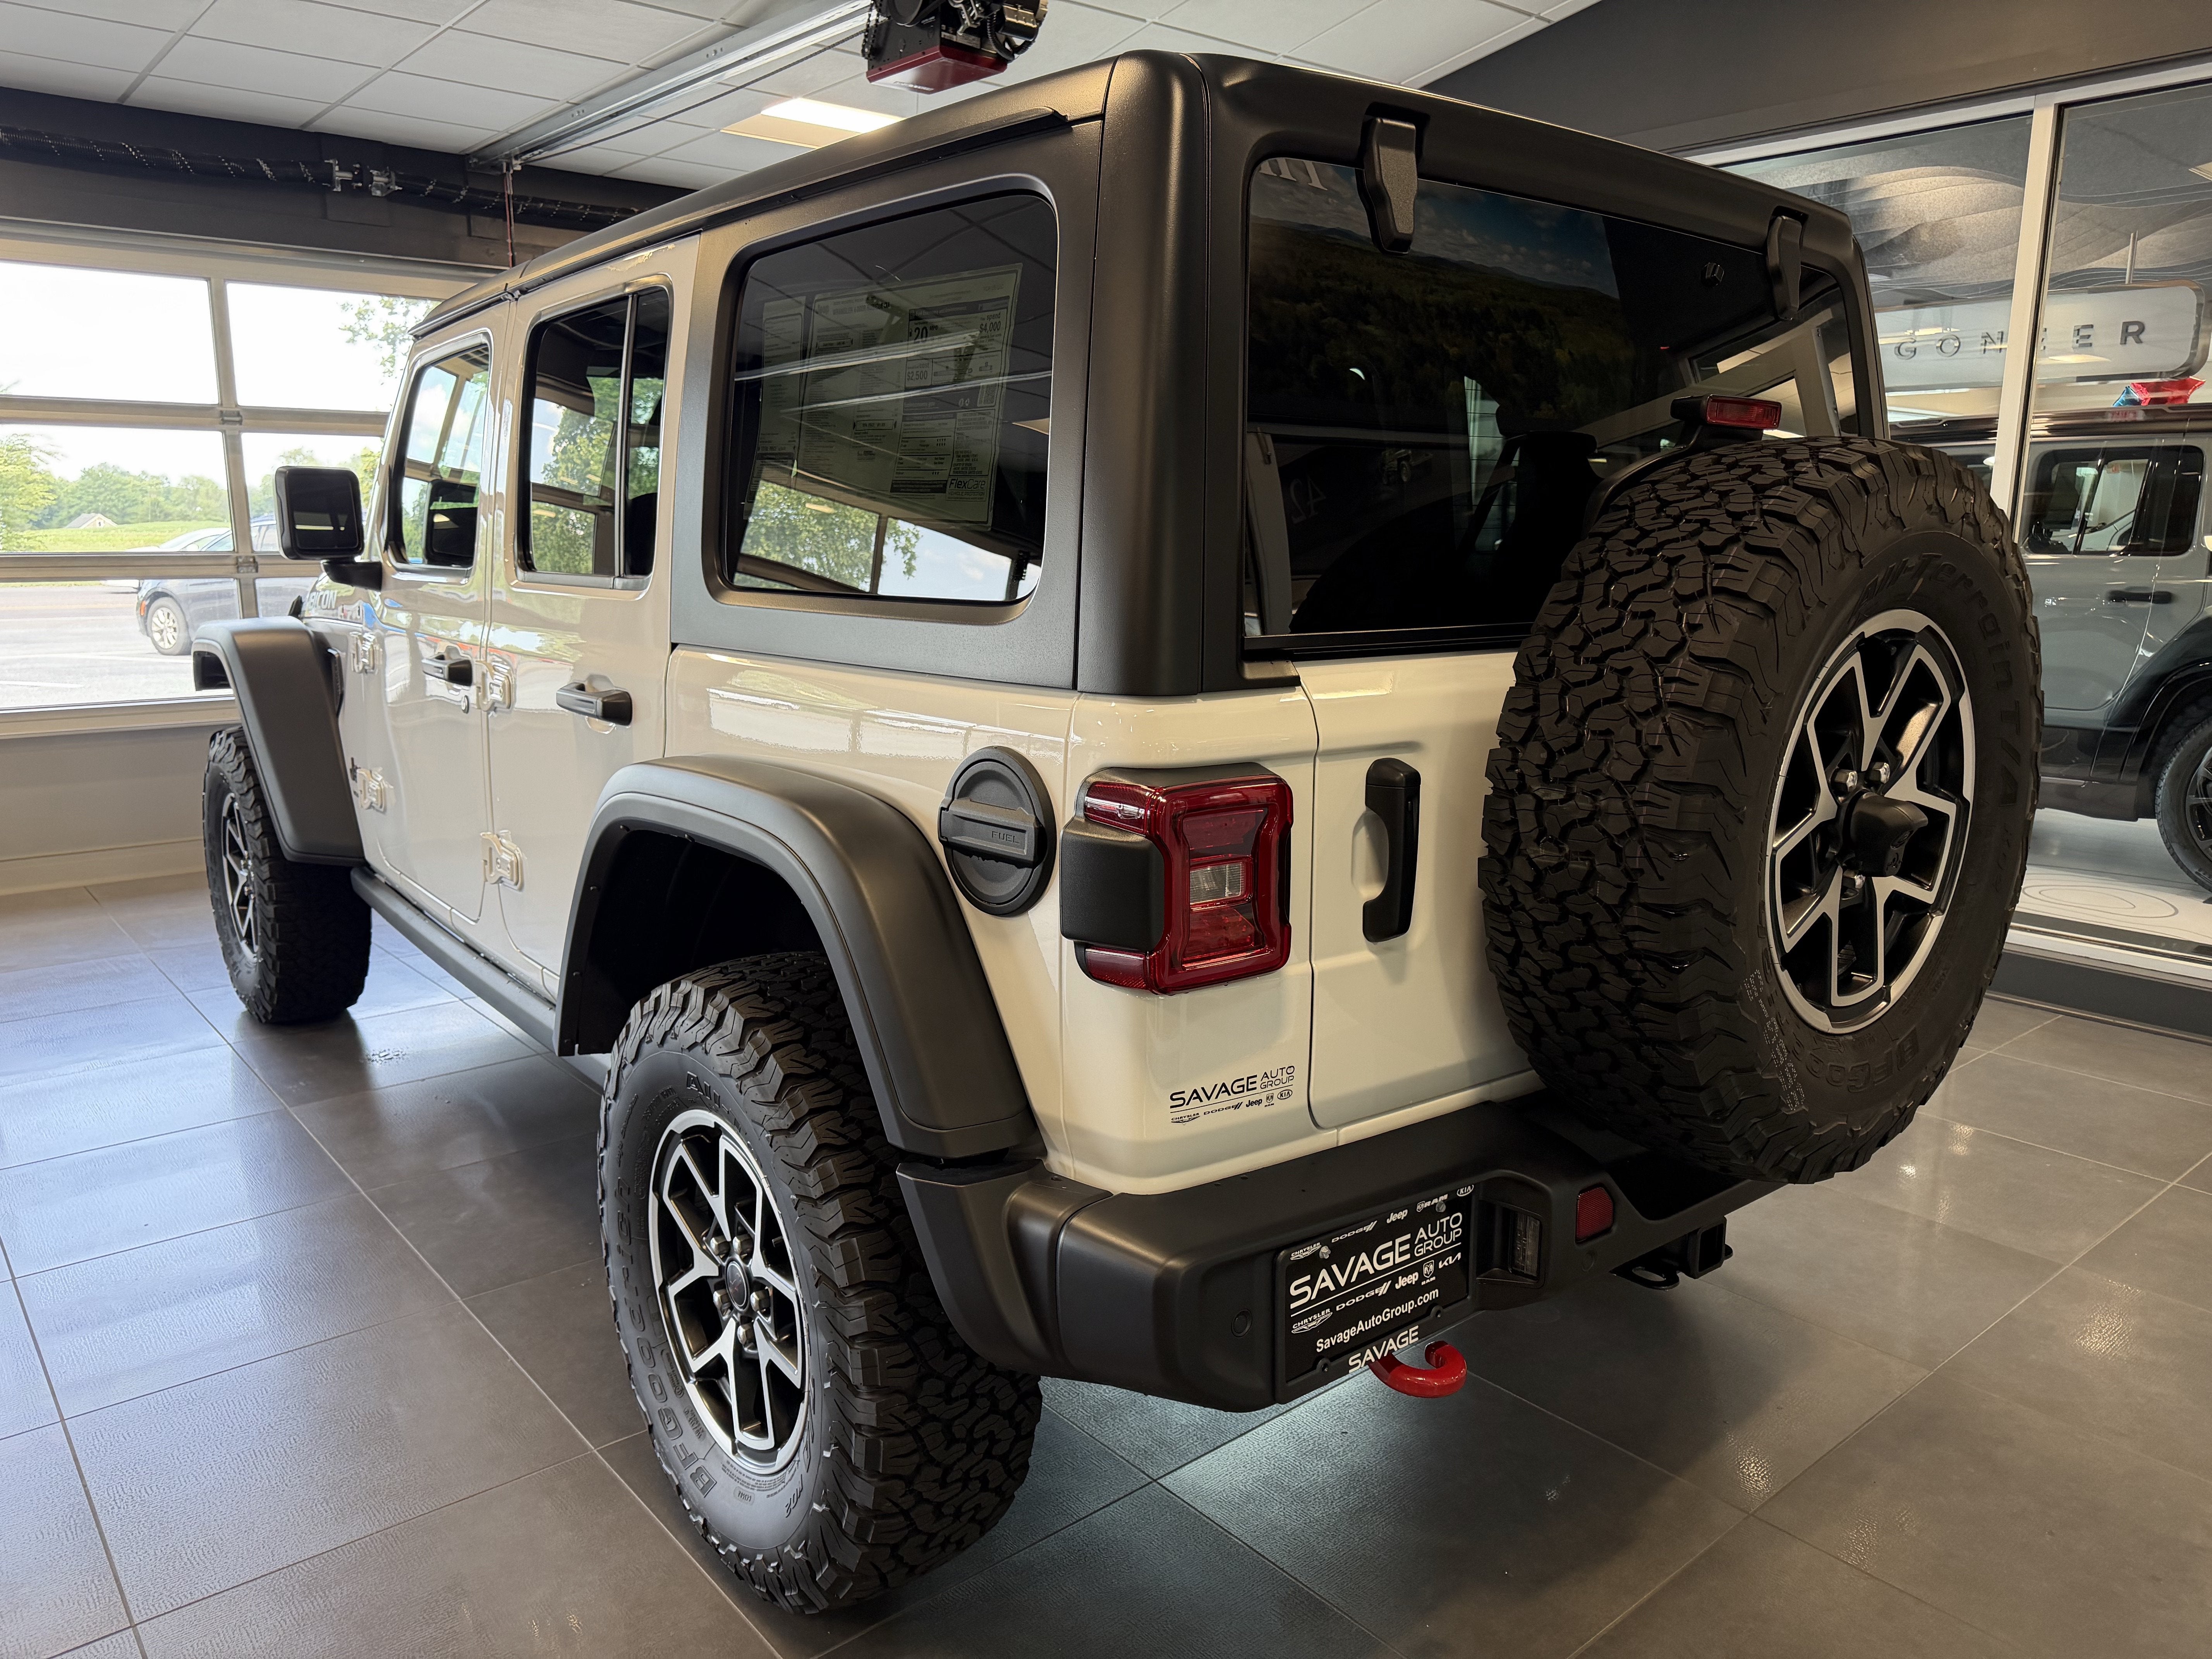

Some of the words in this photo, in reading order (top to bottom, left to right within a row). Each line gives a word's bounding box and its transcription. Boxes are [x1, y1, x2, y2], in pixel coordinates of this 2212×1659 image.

[979, 321, 1001, 334] $4,000
[986, 312, 1001, 321] spend
[914, 326, 928, 343] 20
[907, 370, 928, 381] $2,500
[949, 477, 986, 489] FlexCare
[992, 831, 1020, 843] FUEL
[1170, 1074, 1257, 1109] SAVAGE
[1260, 1065, 1295, 1082] AUTO
[1260, 1075, 1294, 1089] GROUP
[1171, 1113, 1199, 1121] CHRYSLER
[1245, 1098, 1262, 1108] Jeep
[1291, 1242, 1321, 1257] CHRYSLER
[1331, 1224, 1370, 1243] DODGE
[1386, 1209, 1408, 1224] Jeep
[1424, 1194, 1448, 1208] RAM
[1414, 1228, 1462, 1257] GROUP
[1290, 1233, 1411, 1309] SAVAGE
[1415, 1212, 1462, 1244] AUTO
[1292, 1308, 1331, 1329] CHRYSLER
[1336, 1286, 1383, 1311] DODGE
[1395, 1271, 1419, 1290] Jeep
[1421, 1277, 1436, 1285] RAM
[1438, 1252, 1462, 1269] KIA
[1316, 1288, 1439, 1353] SavageAutoGroup.com
[1348, 1325, 1419, 1374] SAVAGE
